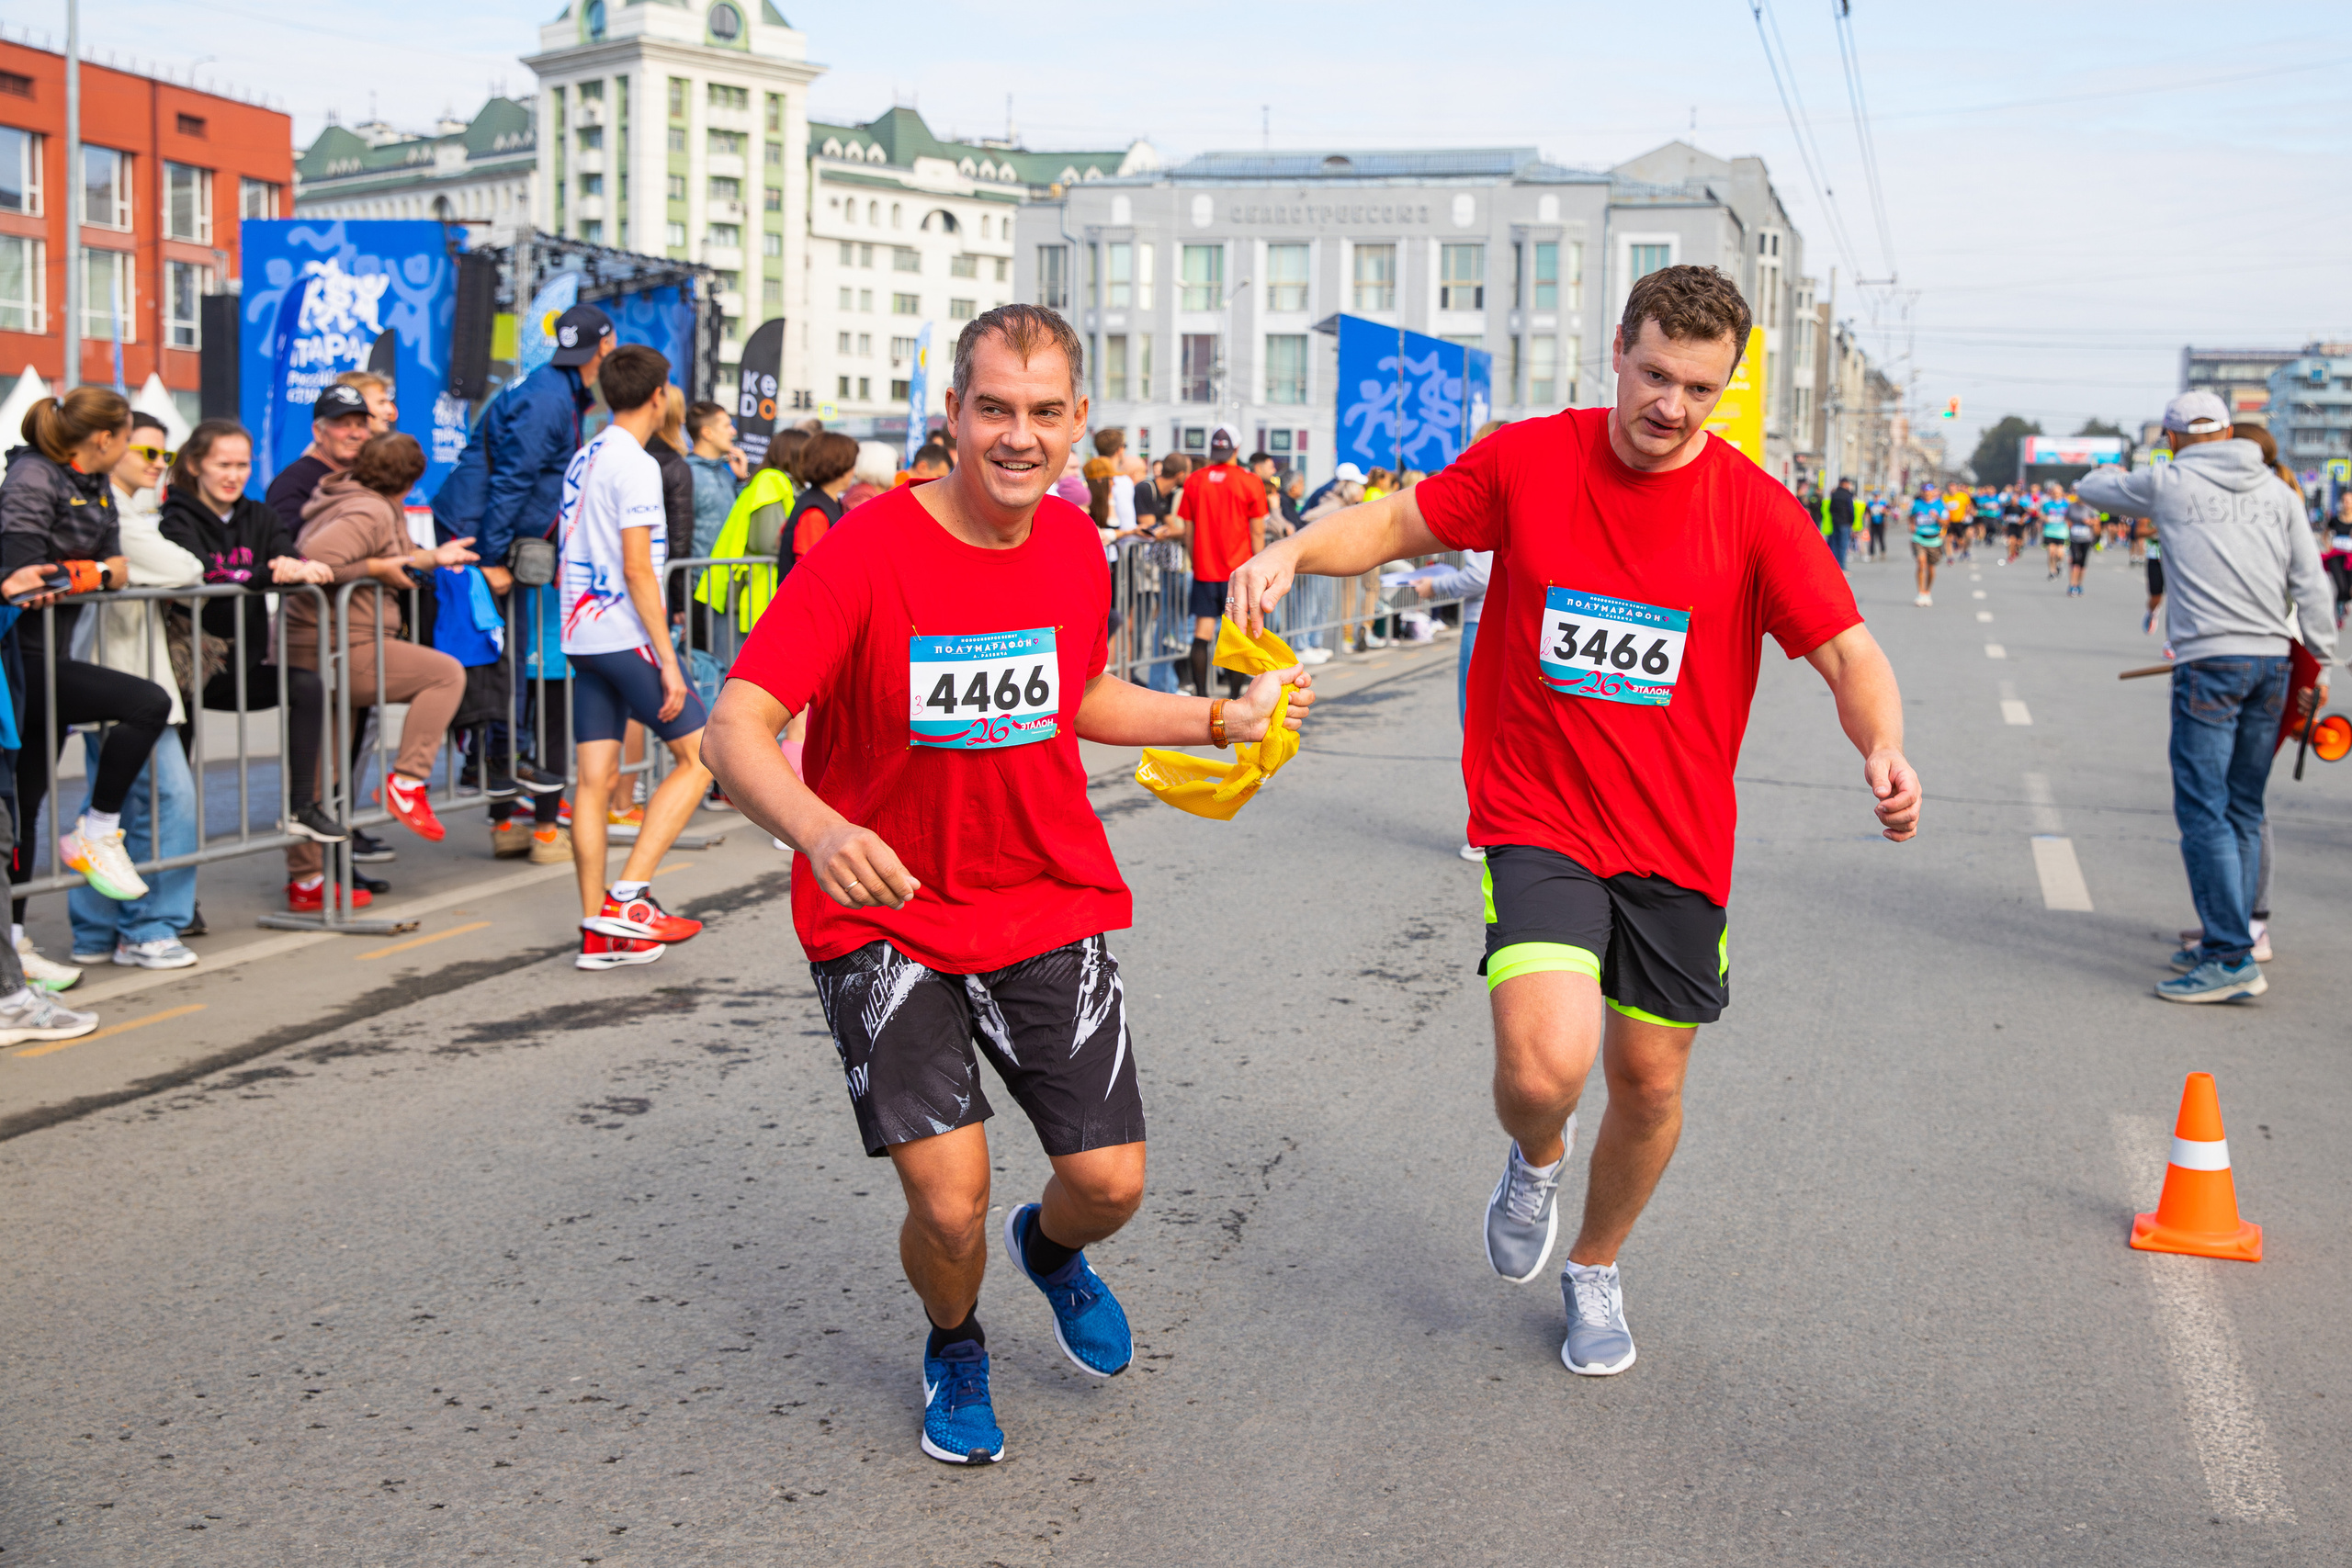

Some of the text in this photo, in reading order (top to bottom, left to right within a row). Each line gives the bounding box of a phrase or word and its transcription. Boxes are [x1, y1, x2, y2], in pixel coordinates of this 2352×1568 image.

[2183, 492, 2281, 528] ASICS
[1566, 598, 1661, 622] ПОЛУМАРАФОН
[935, 637, 1032, 654] ПОЛУМАРАФОН
[1540, 636, 1552, 656] 2
[1554, 621, 1669, 675] 3466
[926, 664, 1049, 714] 4466
[1578, 671, 1626, 696] 26
[1632, 684, 1669, 696] ЭТАЛОН
[911, 695, 923, 716] 3
[966, 714, 1012, 746] 26
[1020, 718, 1054, 731] ЭТАЛОН
